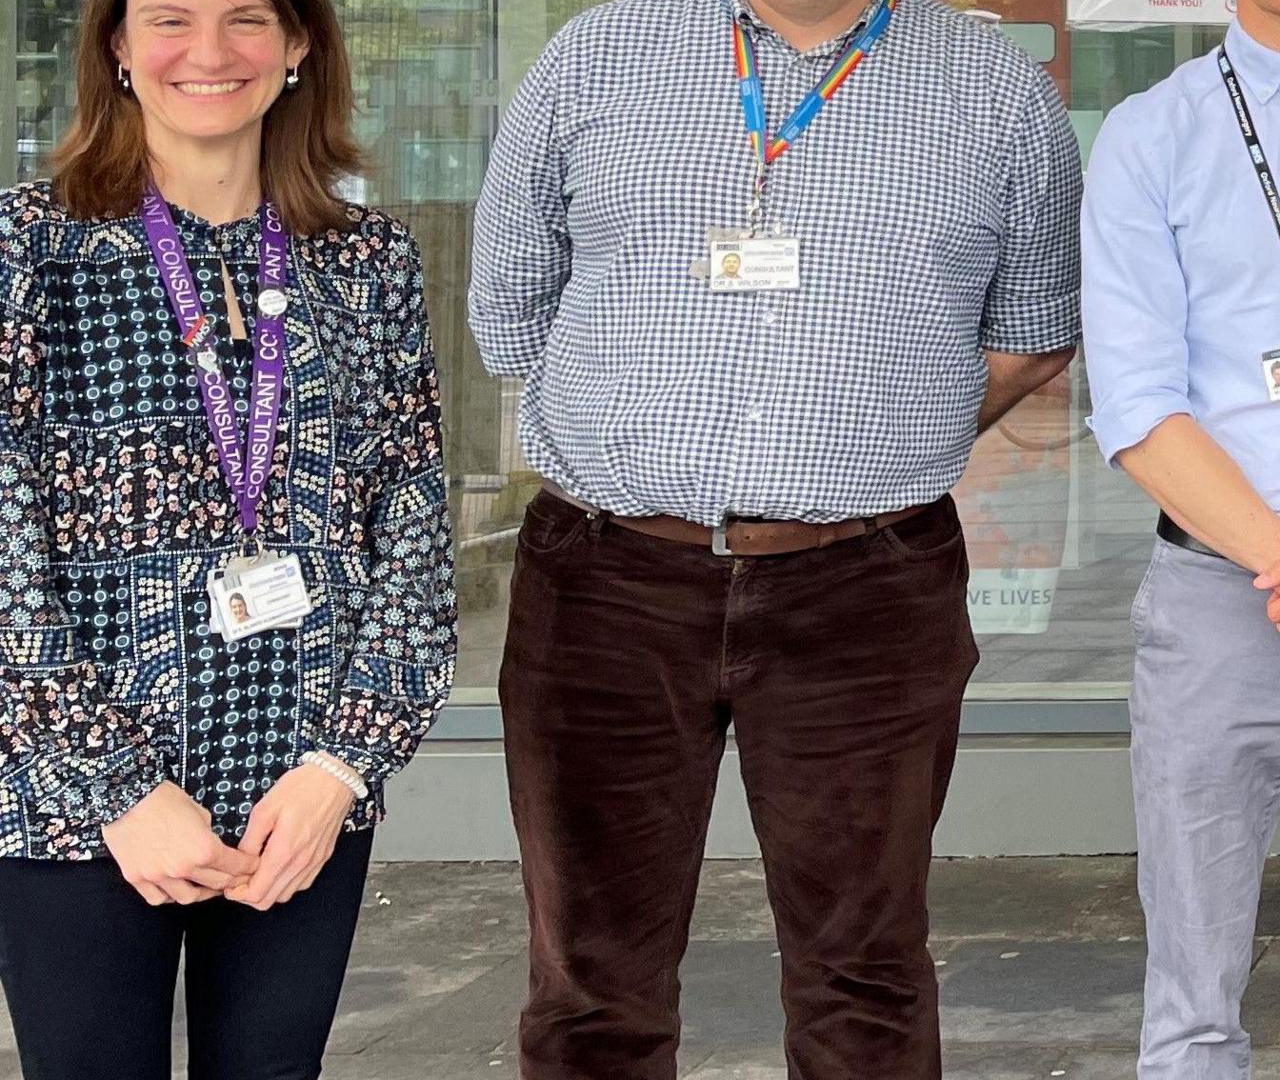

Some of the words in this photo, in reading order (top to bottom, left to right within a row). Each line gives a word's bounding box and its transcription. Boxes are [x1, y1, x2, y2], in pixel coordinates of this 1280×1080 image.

[1250, 142, 1265, 165] NHS
[1260, 171, 1275, 197] Oxford
[157, 237, 200, 329] CONSULT
[246, 371, 277, 500] CONSULTANT
[969, 590, 992, 606] VE
[1000, 589, 1052, 606] LIVES
